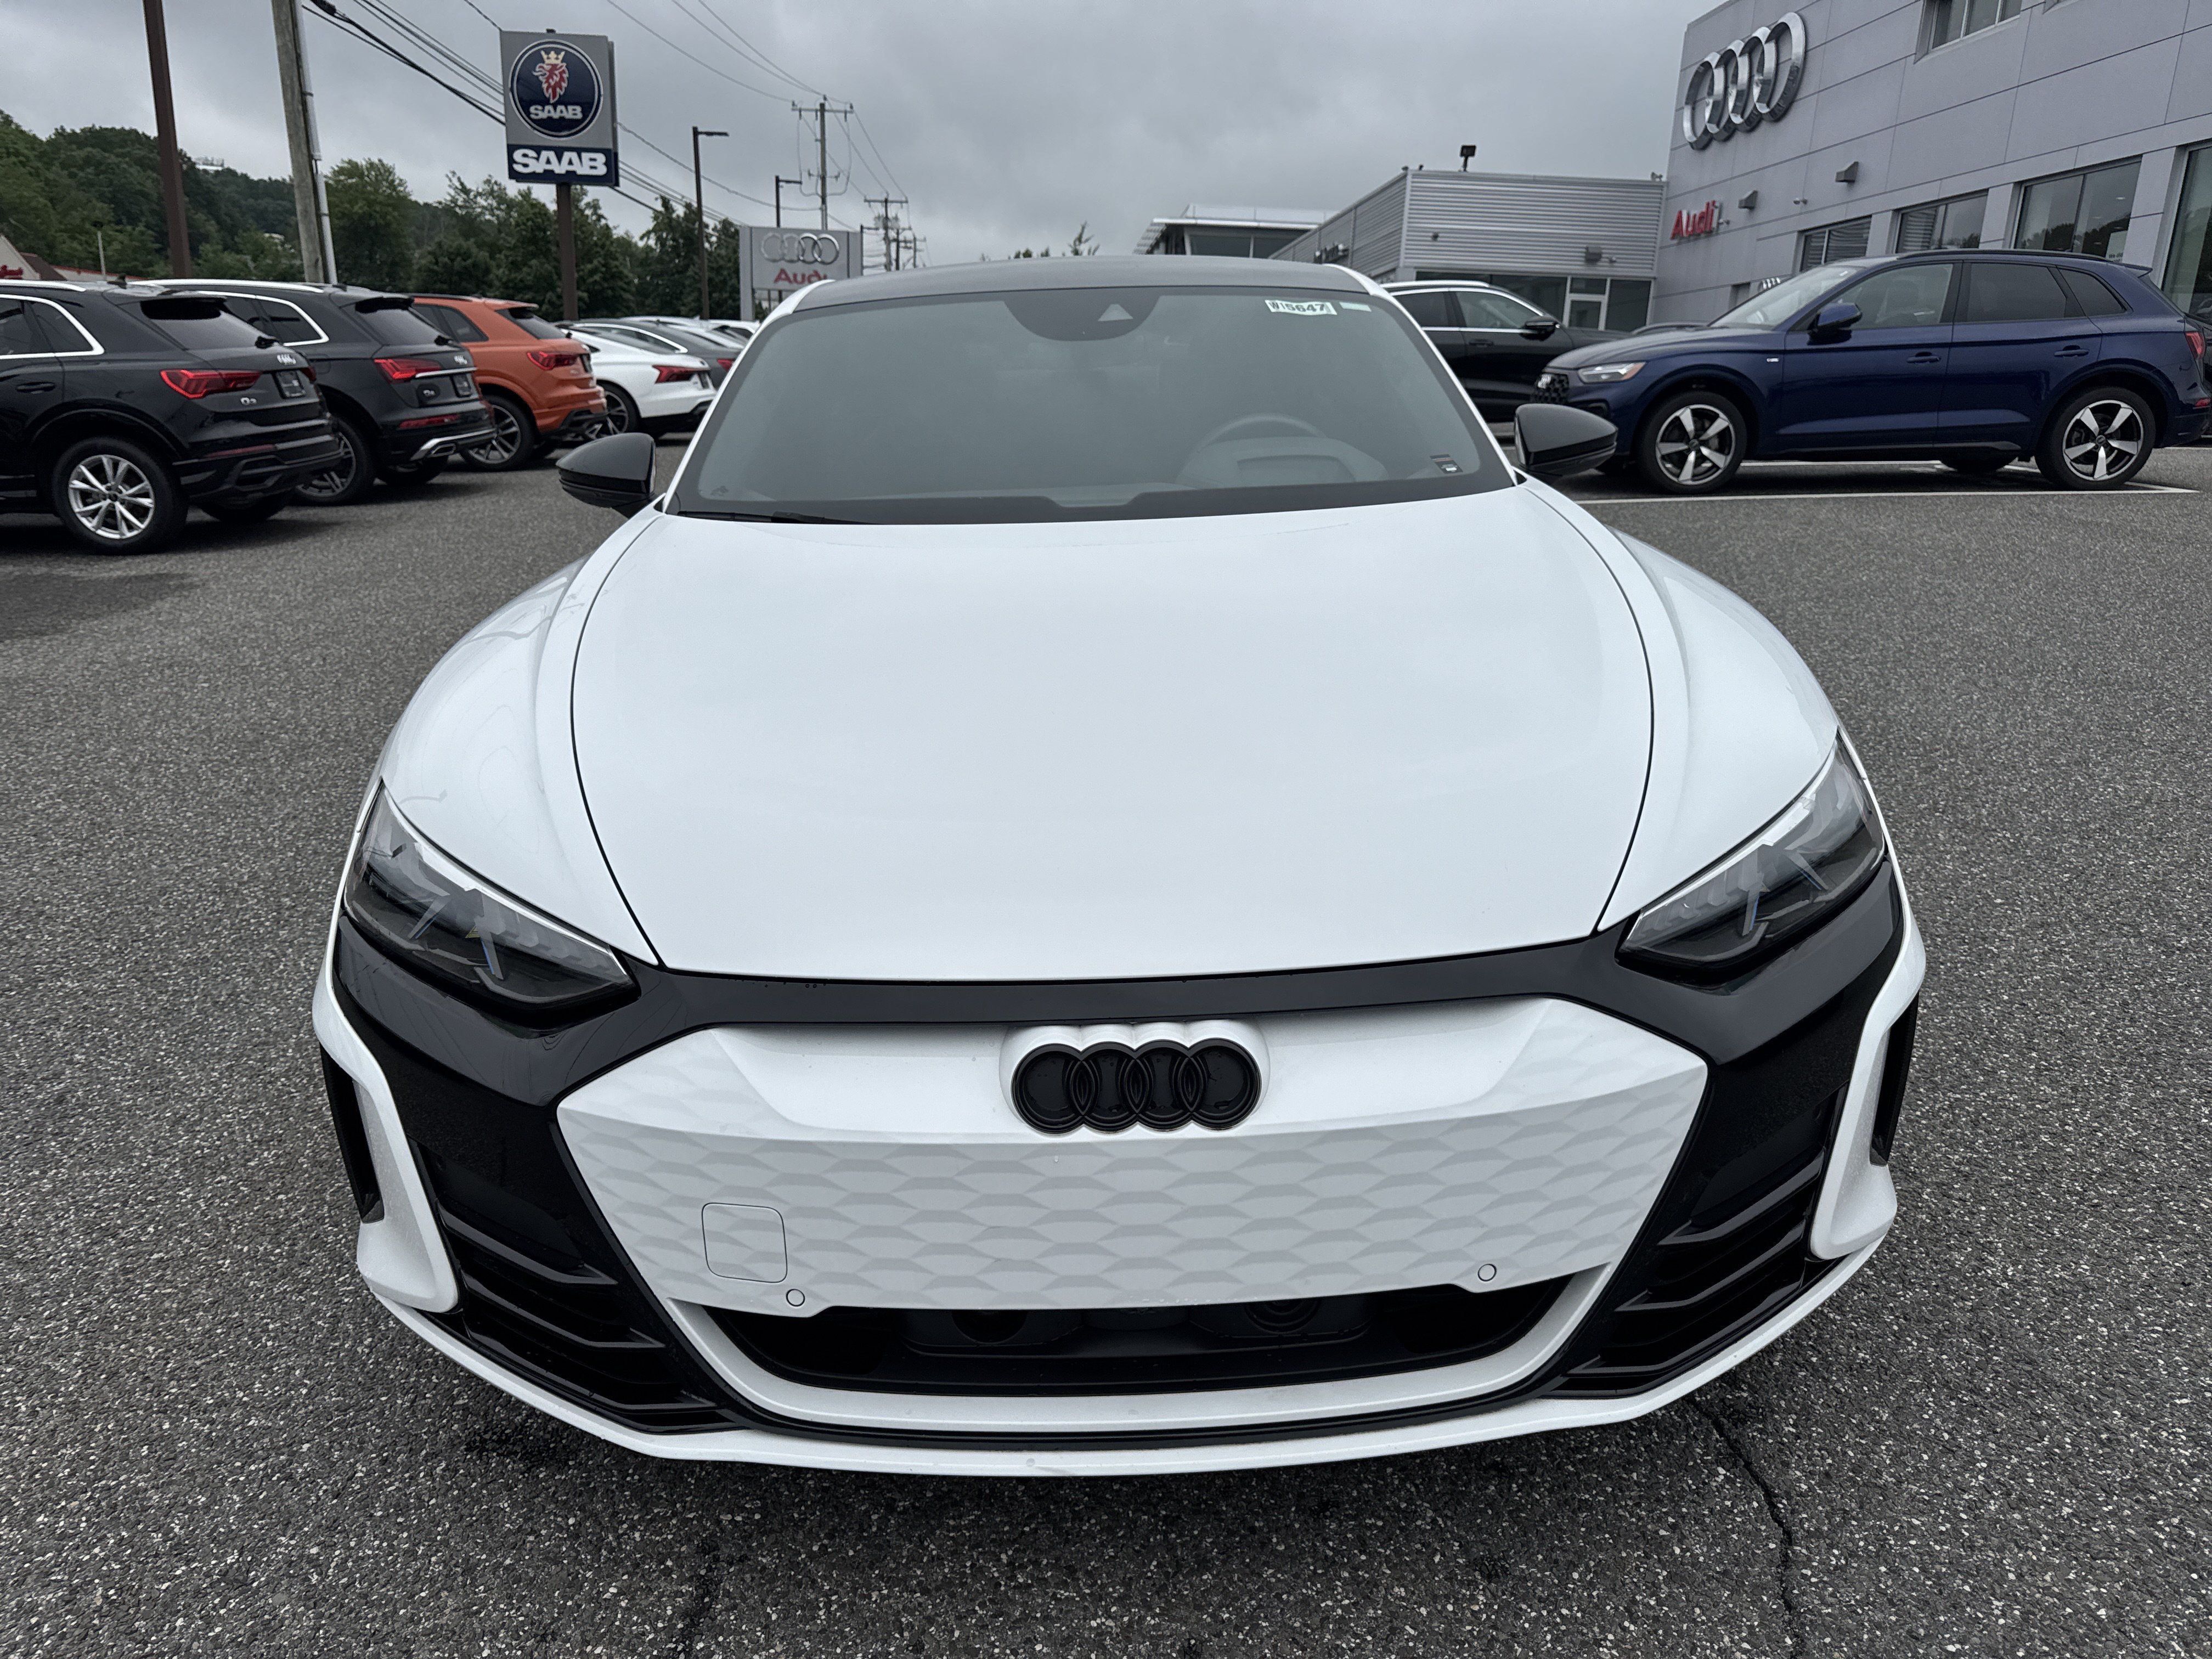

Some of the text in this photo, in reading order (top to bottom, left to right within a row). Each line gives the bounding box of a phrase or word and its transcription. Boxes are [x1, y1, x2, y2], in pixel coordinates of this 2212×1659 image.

[530, 105, 583, 119] SAAB
[512, 149, 607, 176] SAAB
[1671, 200, 1716, 240] Audi
